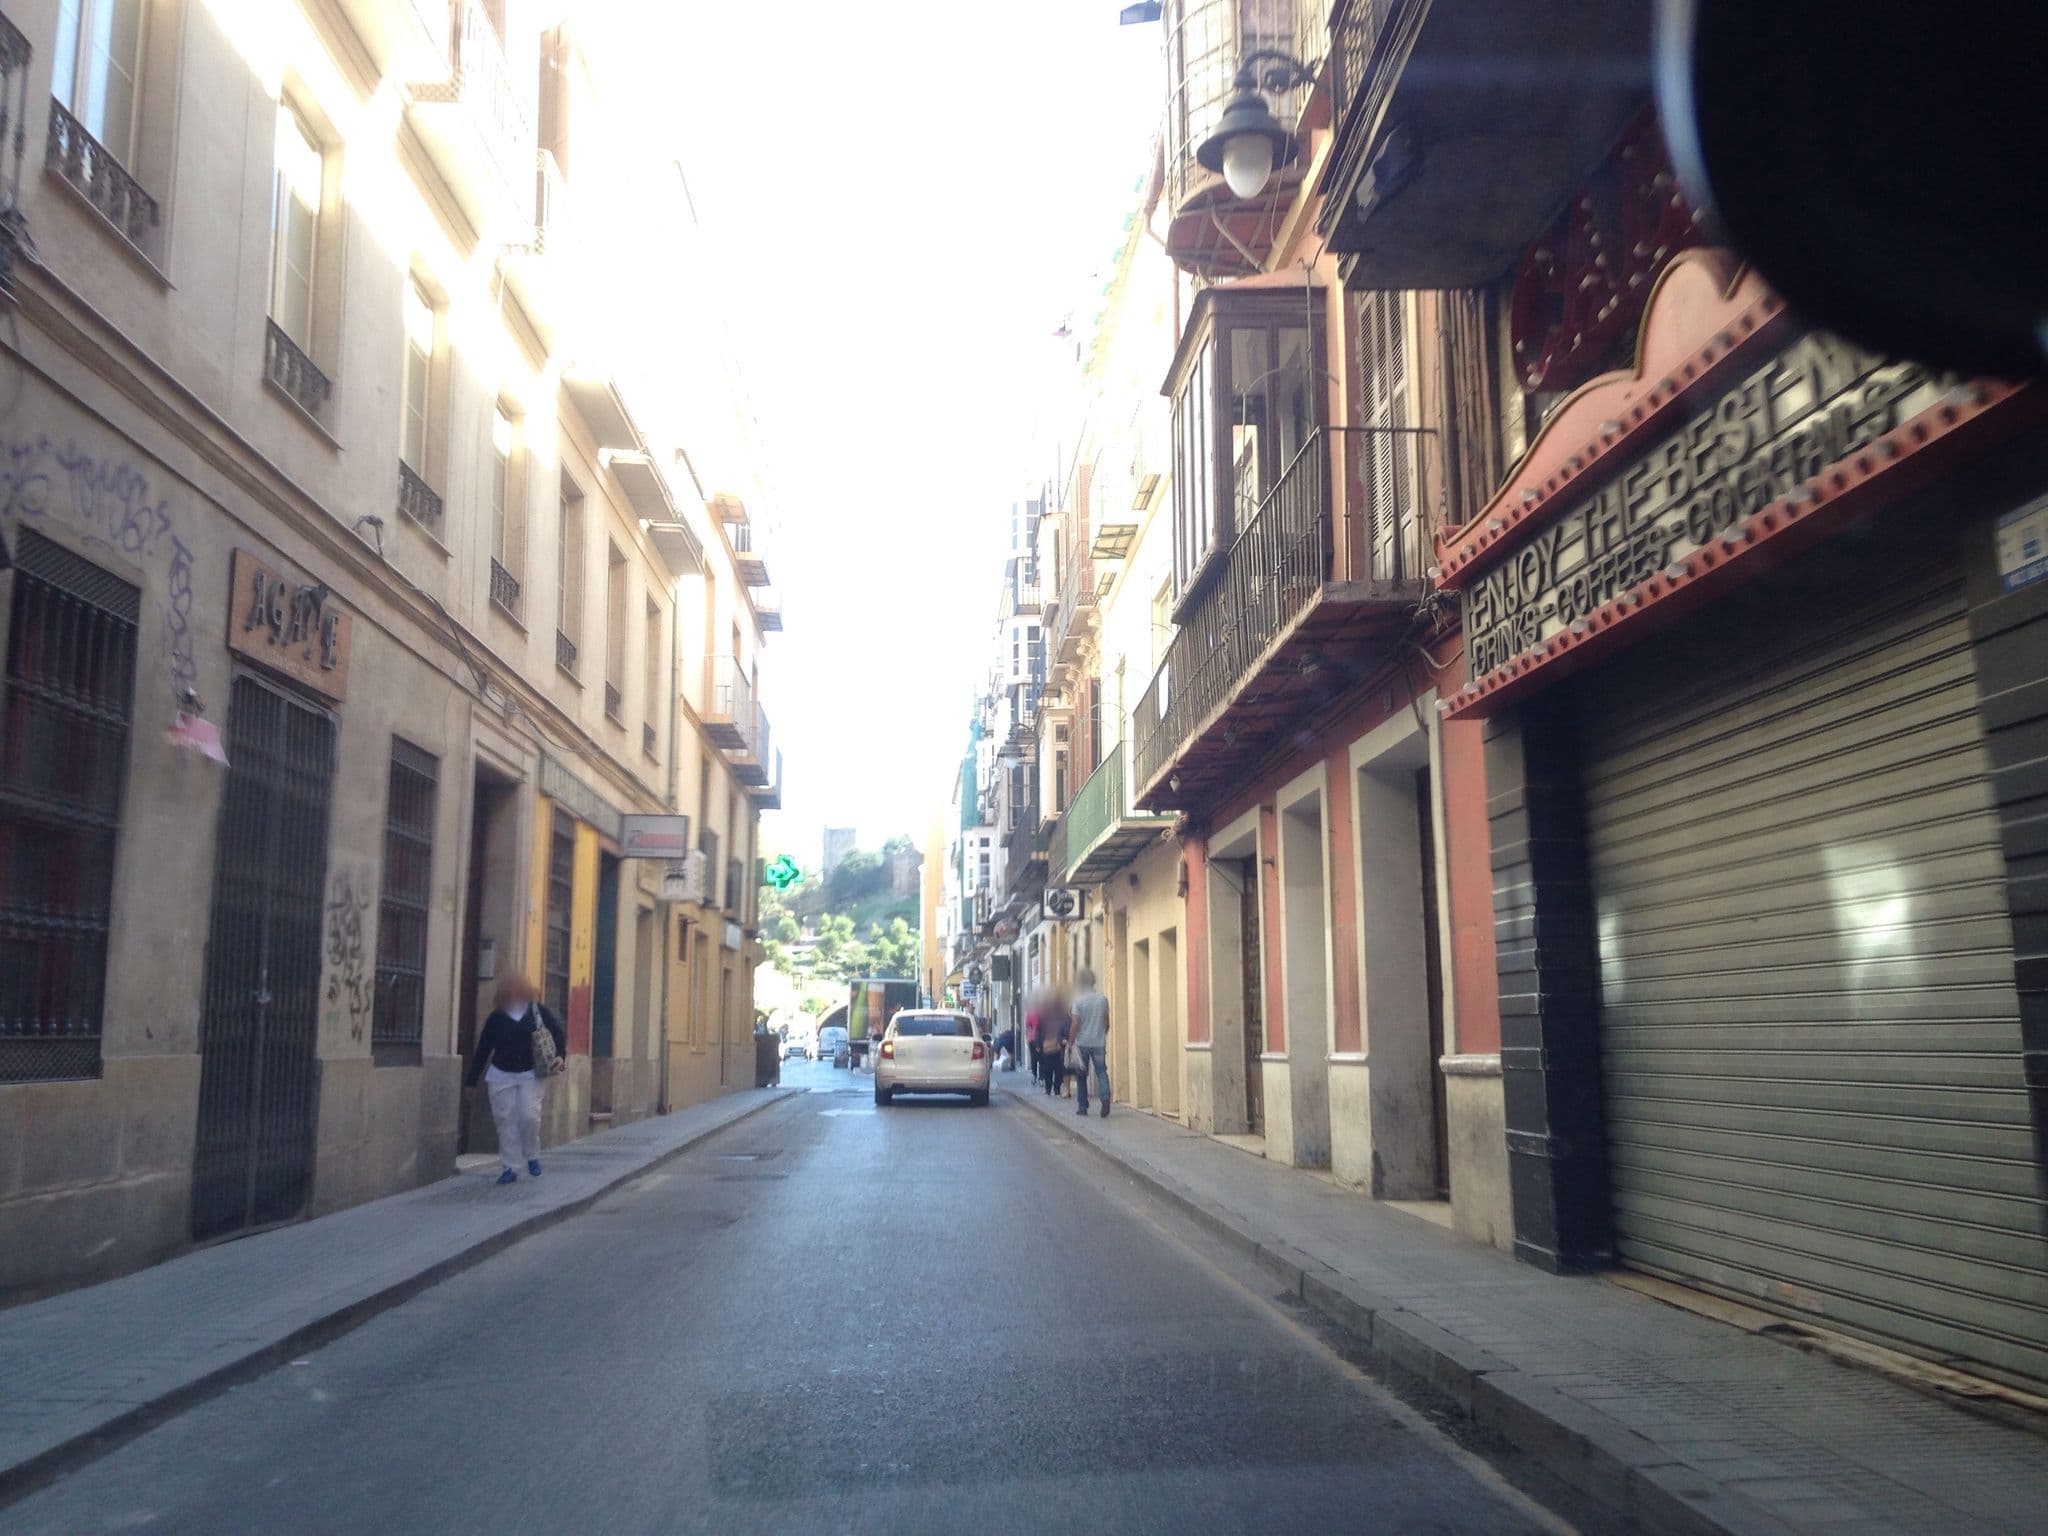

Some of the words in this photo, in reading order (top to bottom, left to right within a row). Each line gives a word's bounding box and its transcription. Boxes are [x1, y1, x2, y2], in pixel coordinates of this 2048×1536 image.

[1470, 524, 1563, 634] ENJOY
[1574, 460, 1655, 564] THE
[1663, 357, 1781, 503] BEST
[1471, 604, 1540, 682] DRINKS
[1557, 525, 1670, 626] COFFEES
